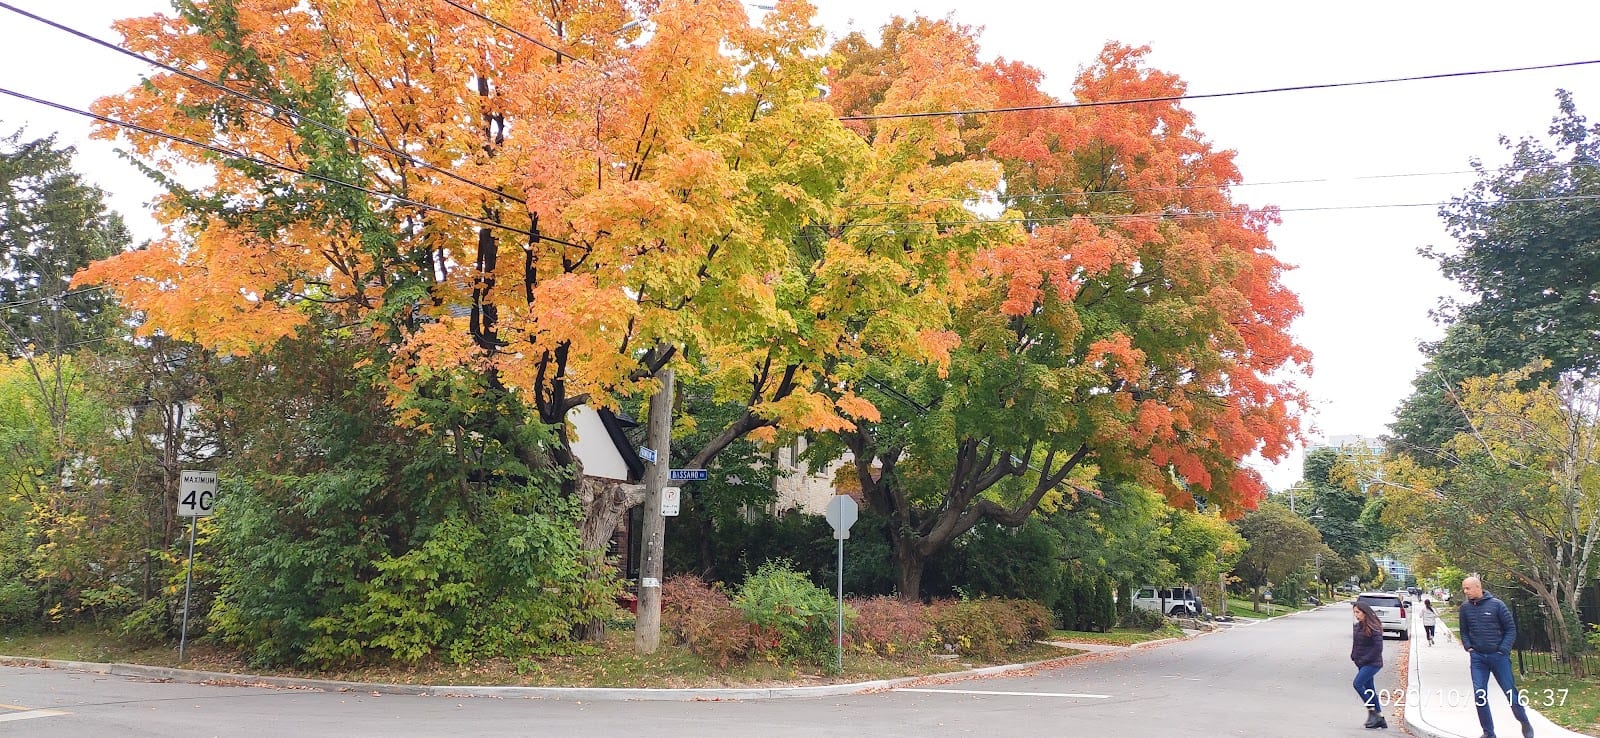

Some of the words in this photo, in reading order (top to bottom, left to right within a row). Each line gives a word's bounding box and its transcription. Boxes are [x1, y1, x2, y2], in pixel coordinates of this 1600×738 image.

[672, 471, 698, 479] BASSANO
[184, 476, 215, 484] MAXIMUM
[181, 490, 213, 510] 40
